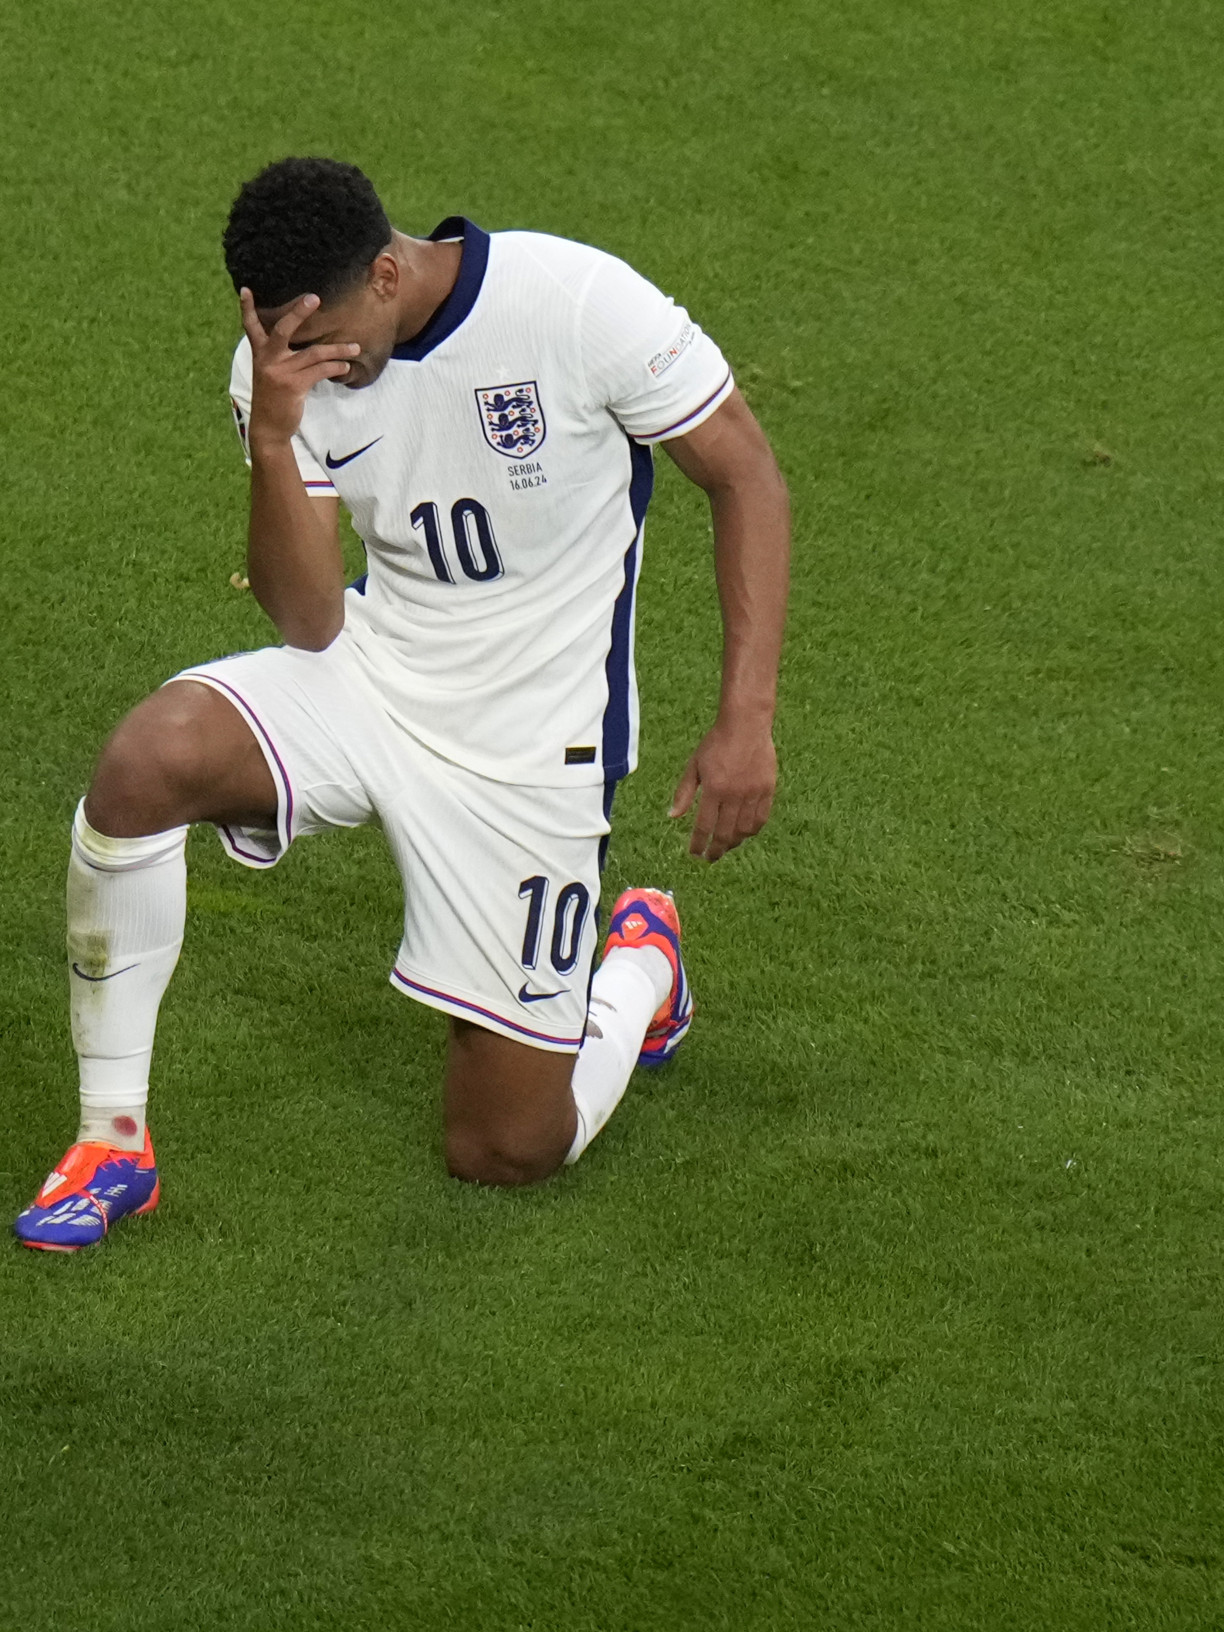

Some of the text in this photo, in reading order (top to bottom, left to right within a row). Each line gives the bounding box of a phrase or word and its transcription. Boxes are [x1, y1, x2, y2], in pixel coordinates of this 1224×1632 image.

[507, 461, 543, 477] SERBIA
[509, 474, 547, 491] 16.06.24
[410, 498, 505, 585] 10
[518, 875, 590, 977] 10
